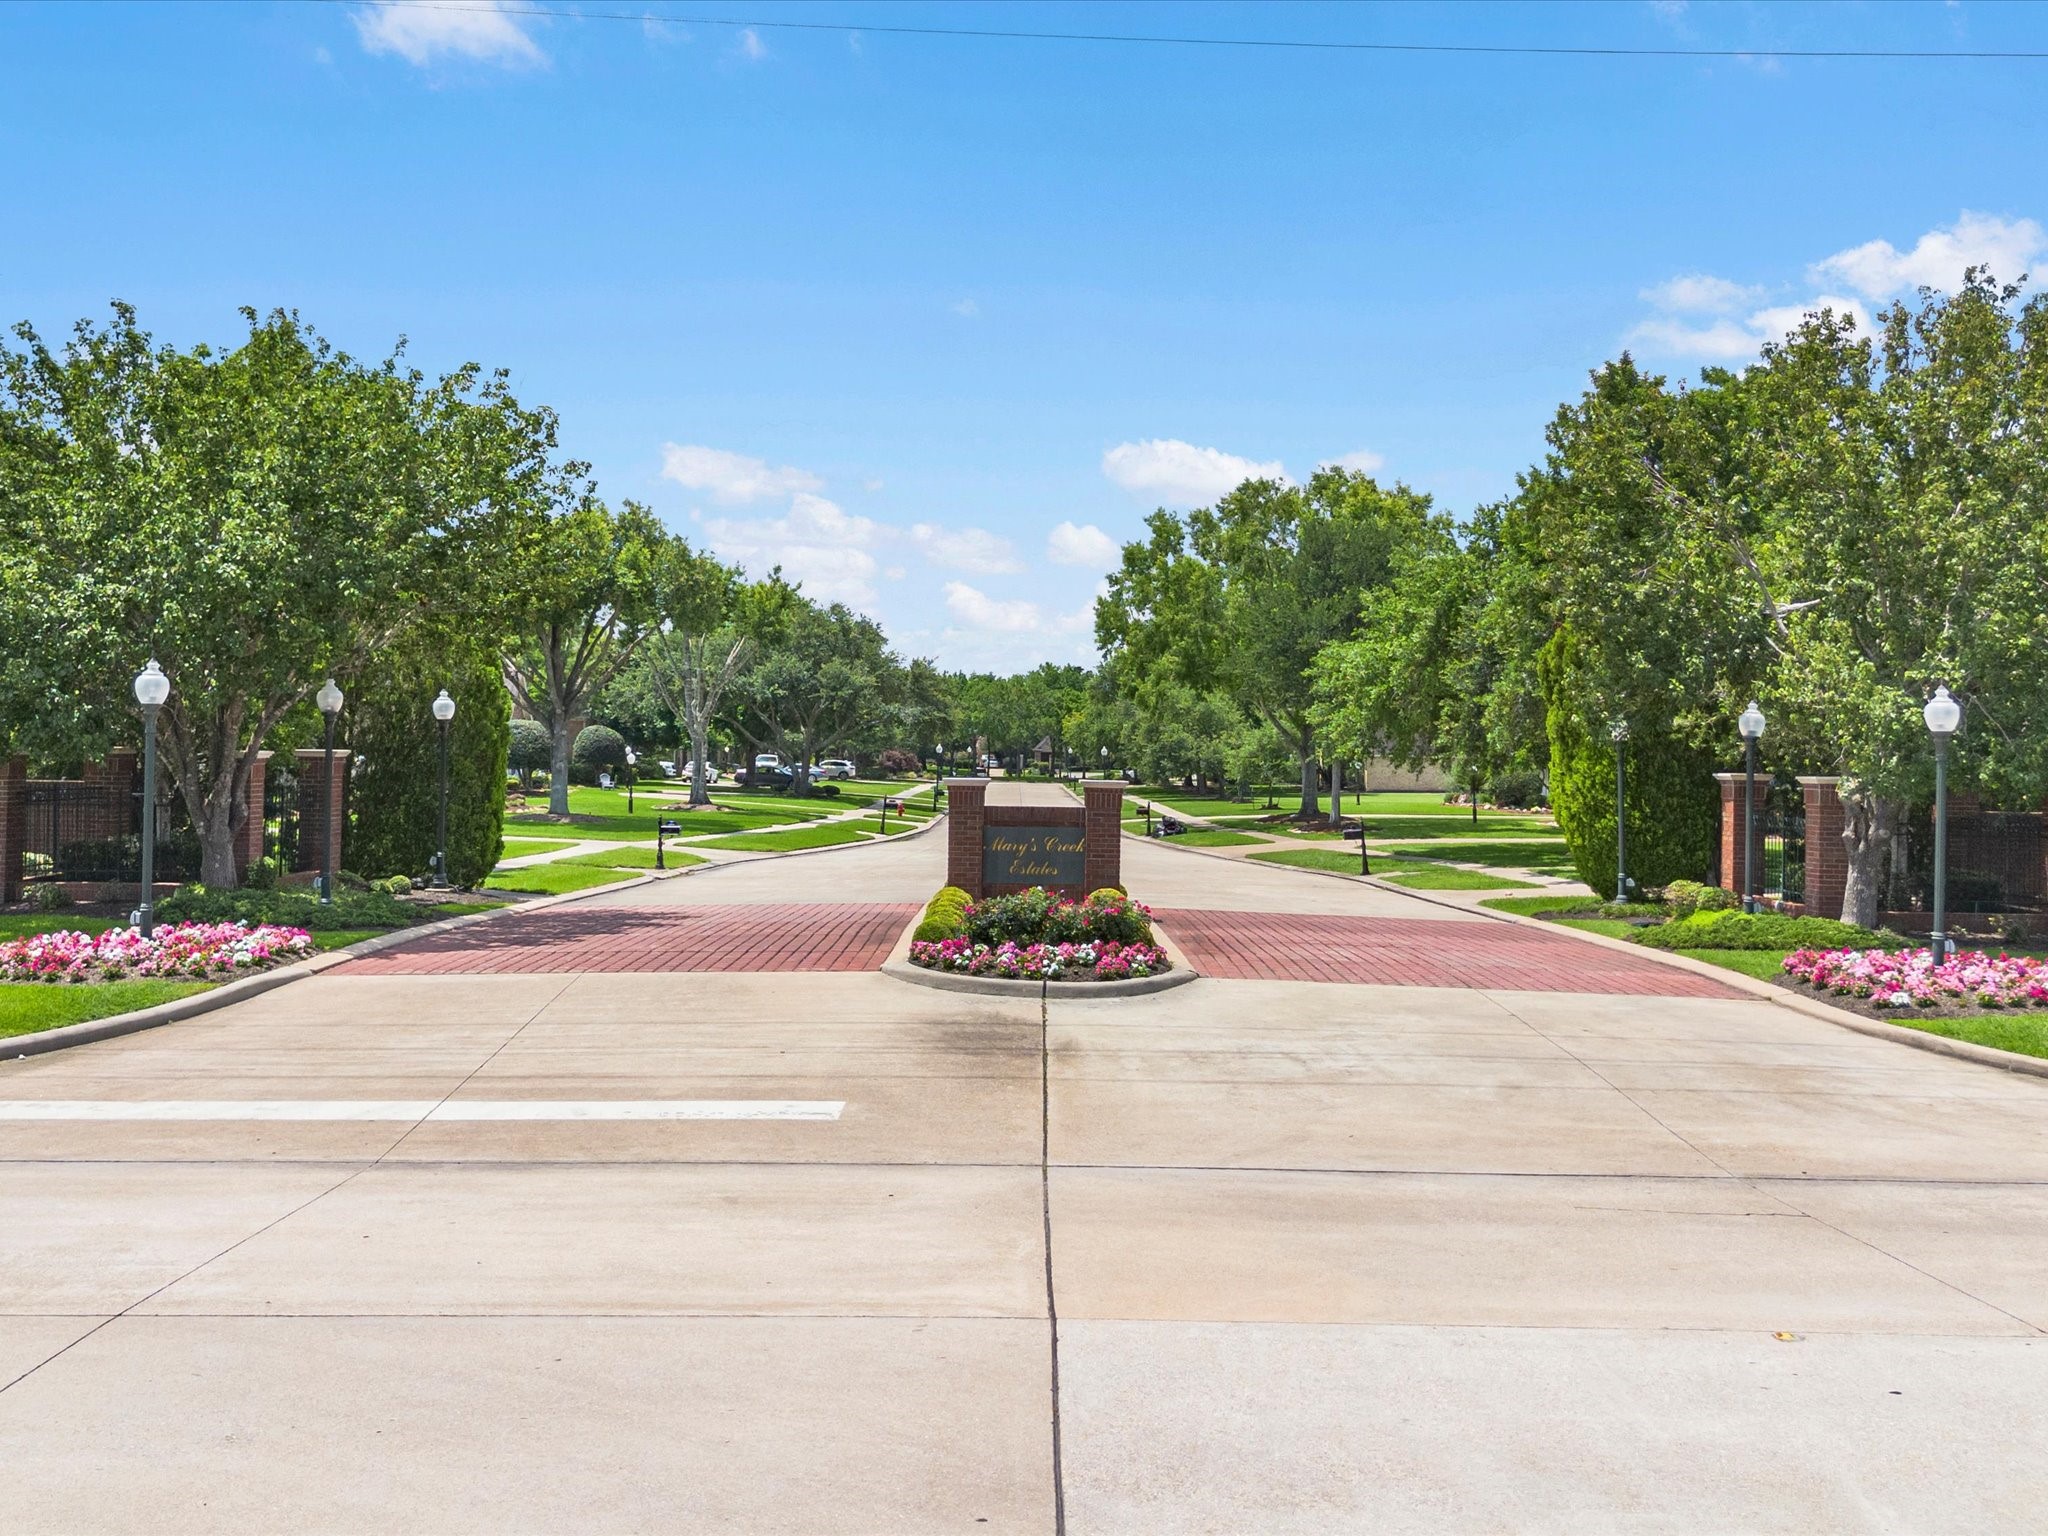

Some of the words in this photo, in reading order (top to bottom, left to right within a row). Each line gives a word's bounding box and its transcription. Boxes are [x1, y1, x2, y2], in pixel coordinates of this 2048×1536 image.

[984, 836, 1037, 857] Mary's
[1043, 836, 1085, 852] Creek
[1009, 859, 1058, 875] Estates
